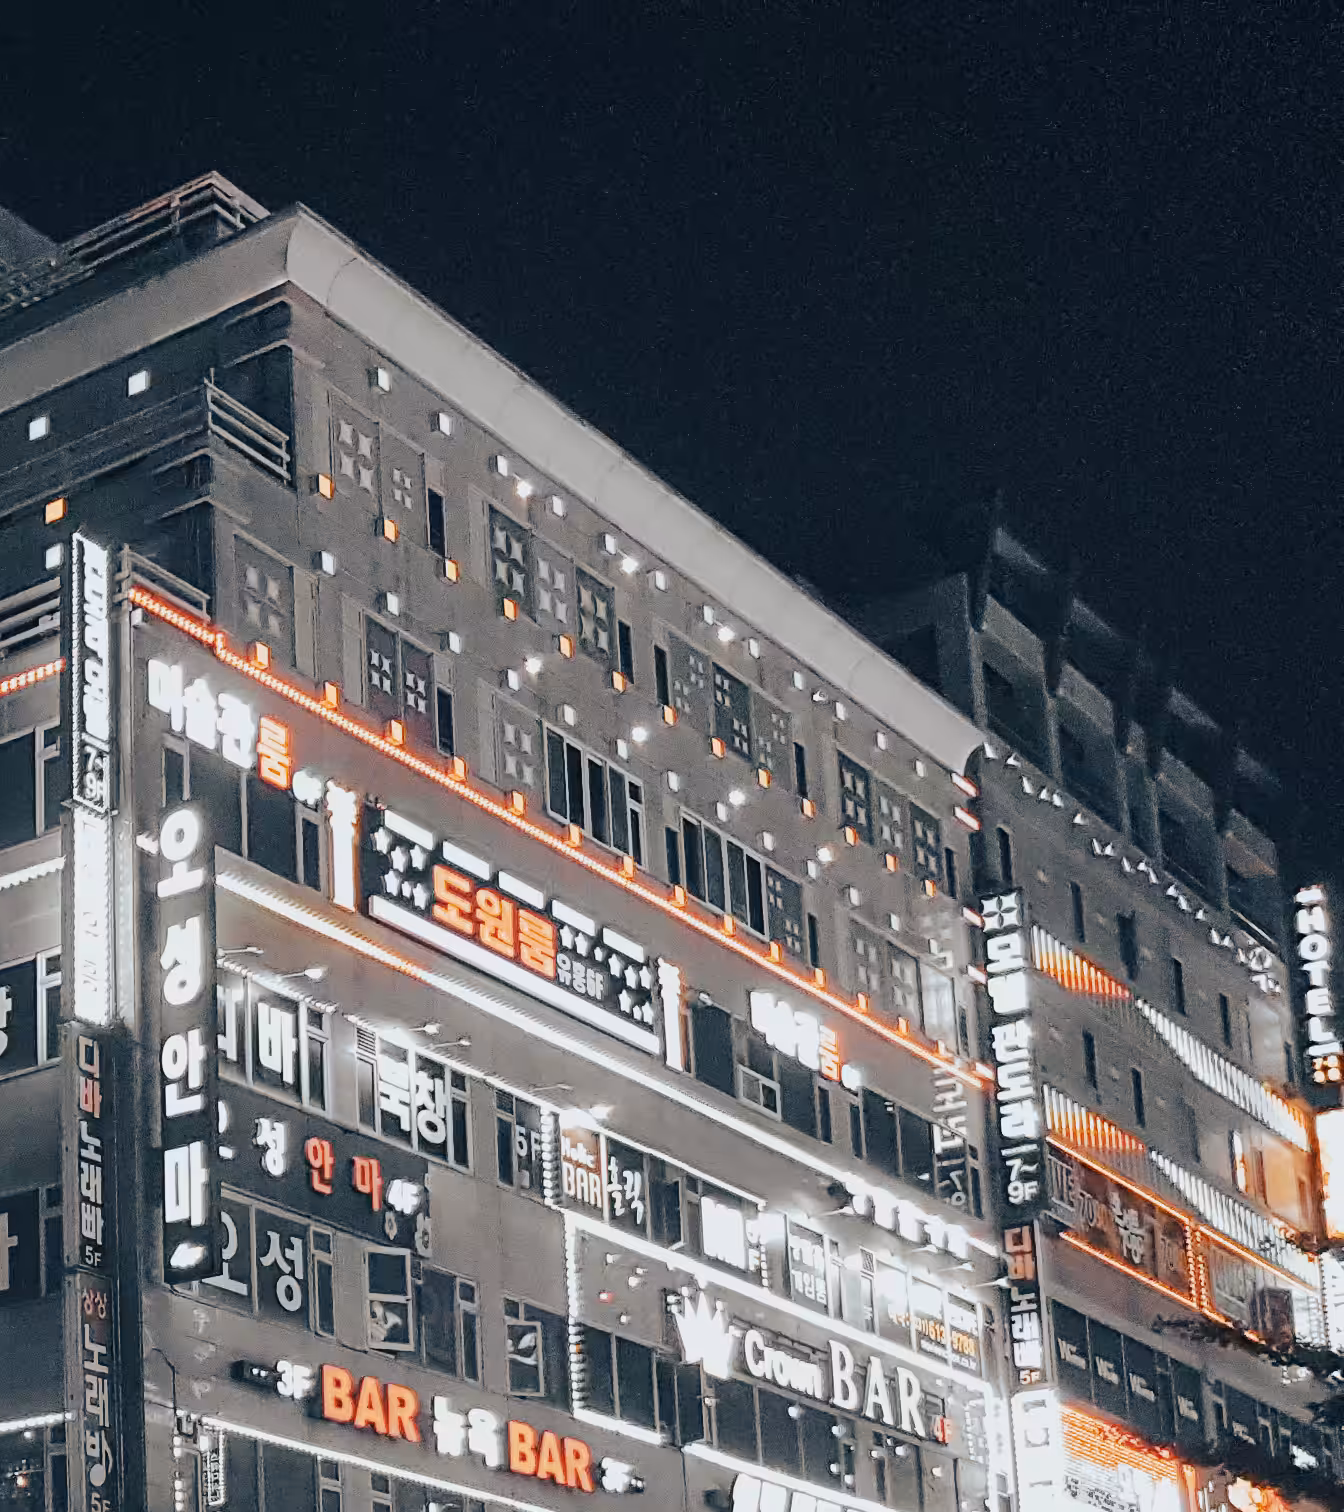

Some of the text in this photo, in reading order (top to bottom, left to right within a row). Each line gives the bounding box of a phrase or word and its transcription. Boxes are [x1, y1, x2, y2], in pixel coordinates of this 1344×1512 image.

[432, 864, 558, 978] 도원룸
[79, 1035, 102, 1118] 디바
[80, 1121, 105, 1246] 노래빠
[561, 1162, 603, 1210] BAR
[84, 1244, 102, 1266] 5F
[322, 1362, 422, 1443] BAR
[506, 1419, 596, 1493] BAR
[744, 1327, 823, 1400] Crown
[828, 1338, 927, 1442] BAR
[1018, 1369, 1041, 1389] 5F
